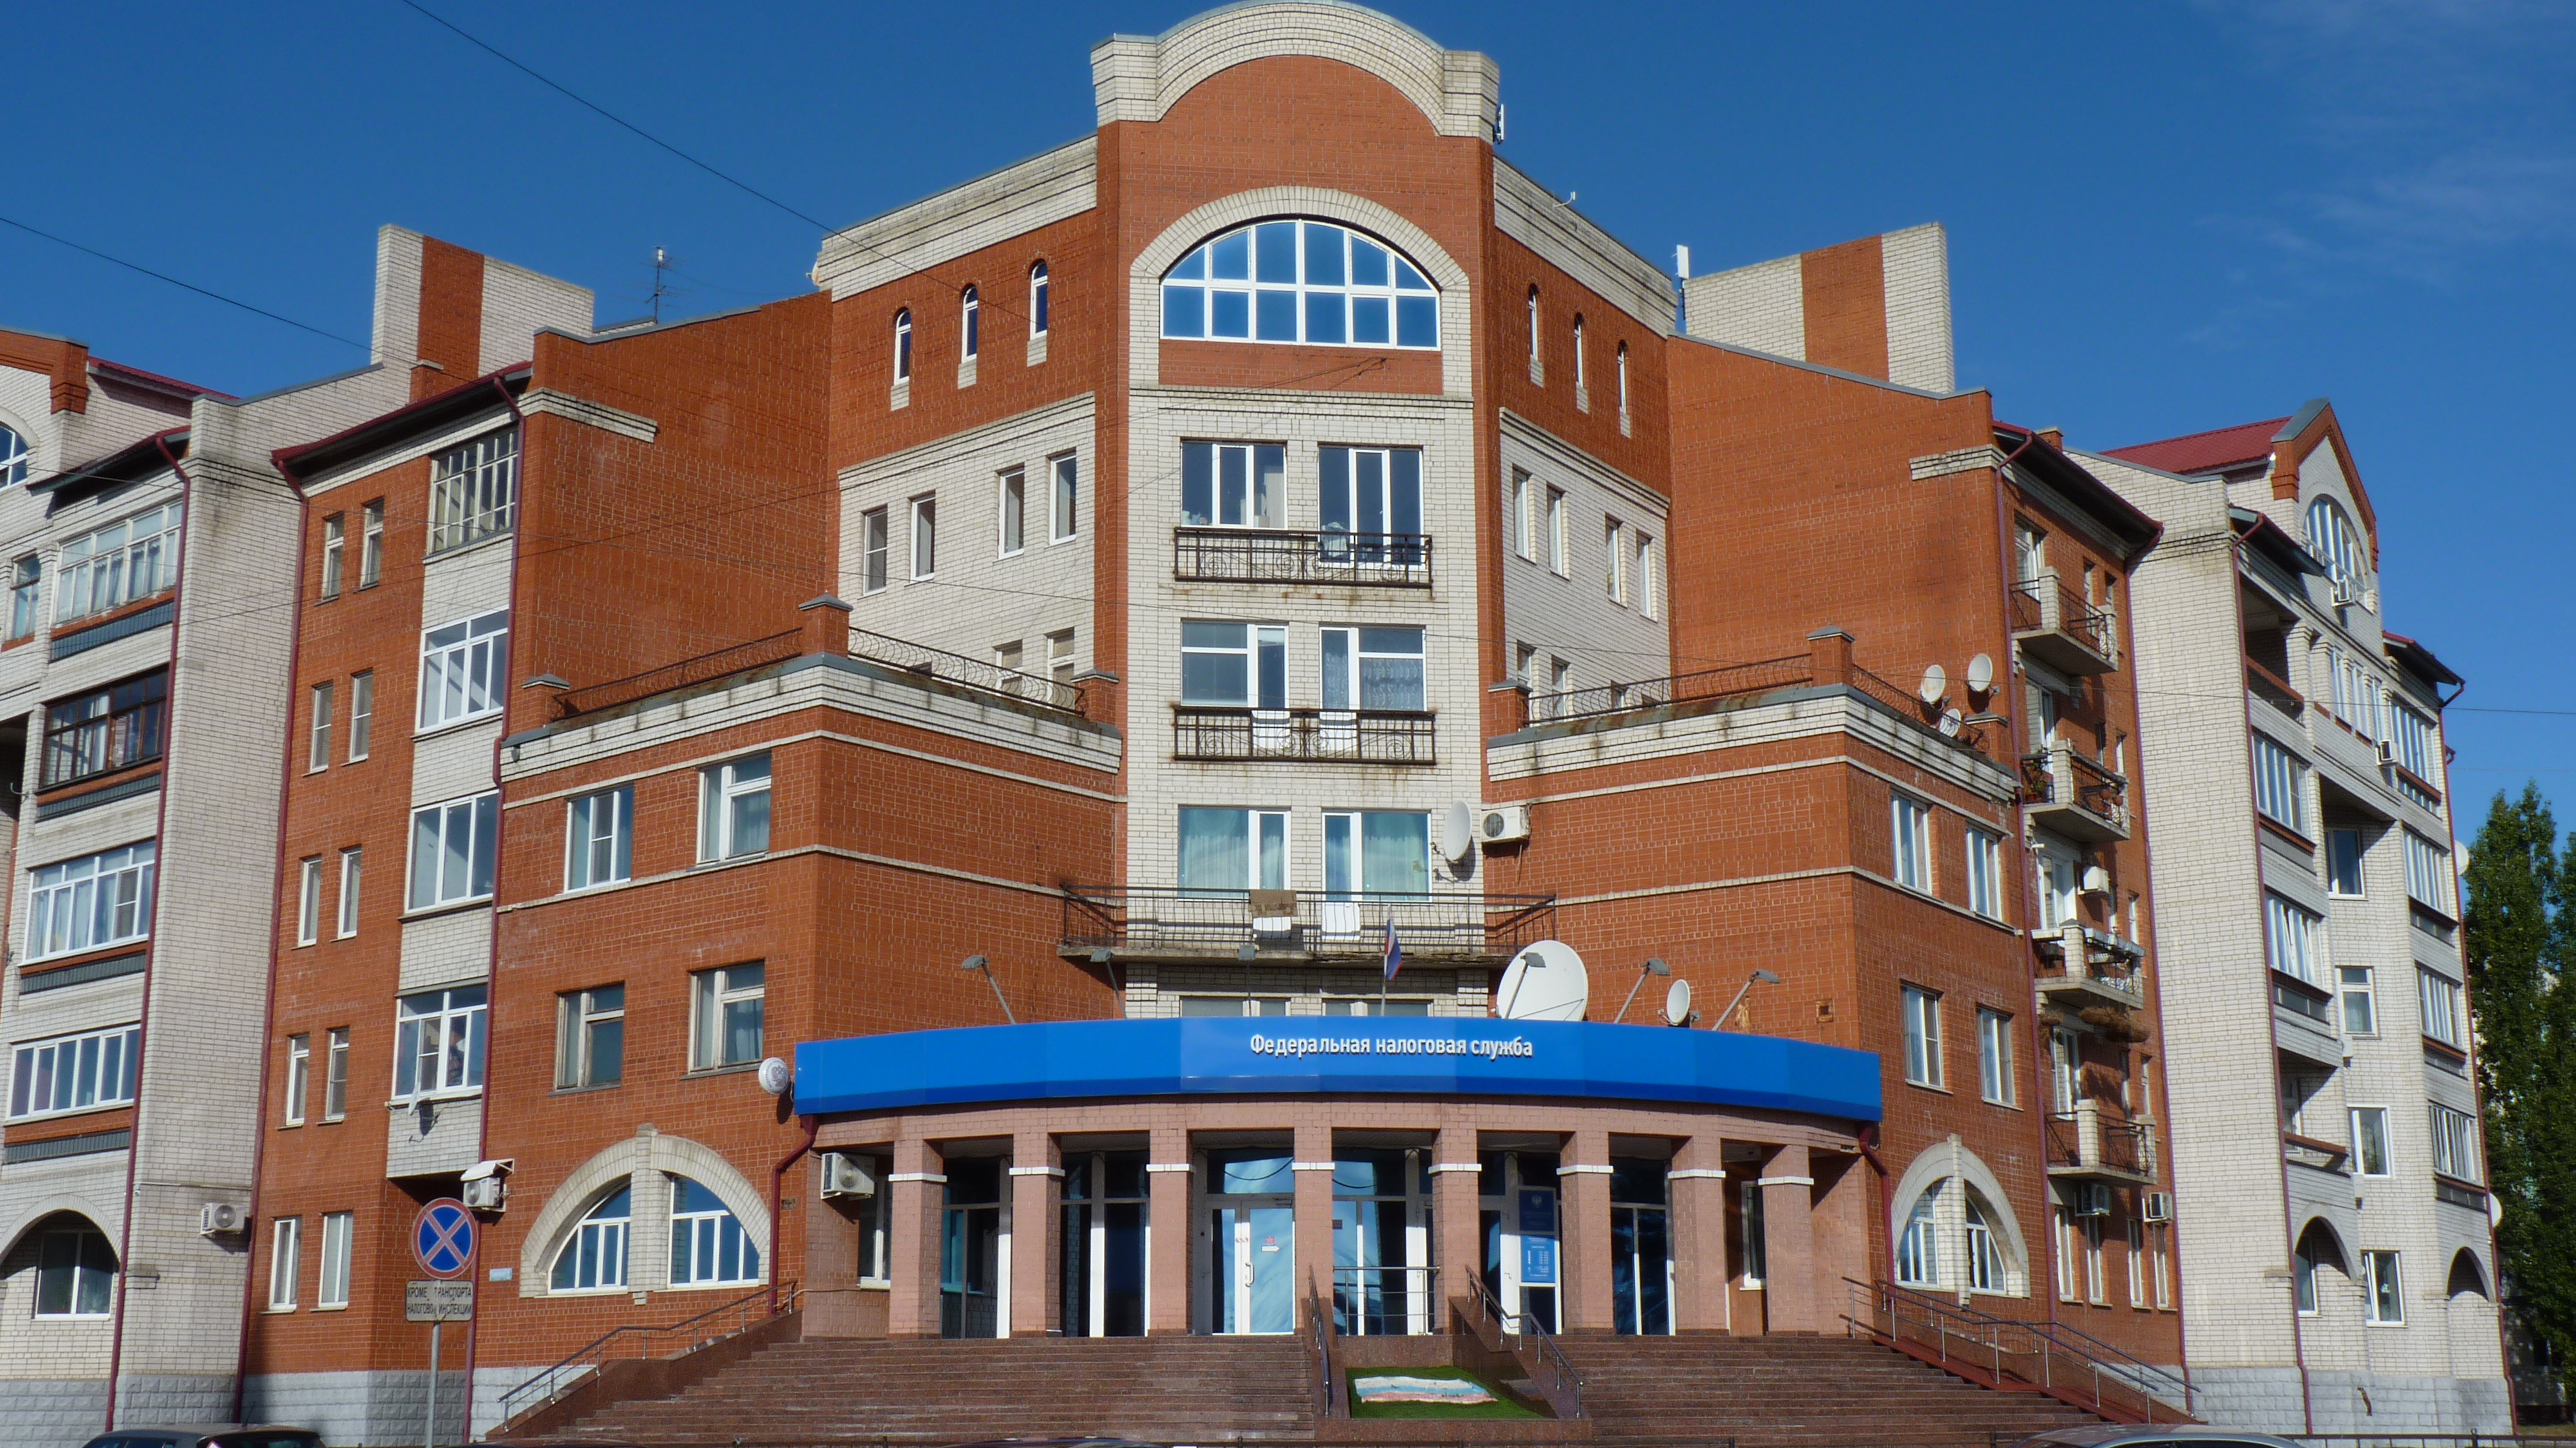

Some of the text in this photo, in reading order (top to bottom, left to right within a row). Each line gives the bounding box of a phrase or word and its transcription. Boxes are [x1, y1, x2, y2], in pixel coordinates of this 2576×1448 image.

[1251, 1034, 1533, 1060] Федеральная налоговая служба
[407, 1286, 472, 1298] КРОМЕ ТРАНСПОРТА
[439, 1303, 472, 1315] ИНСПЕКЦИИ
